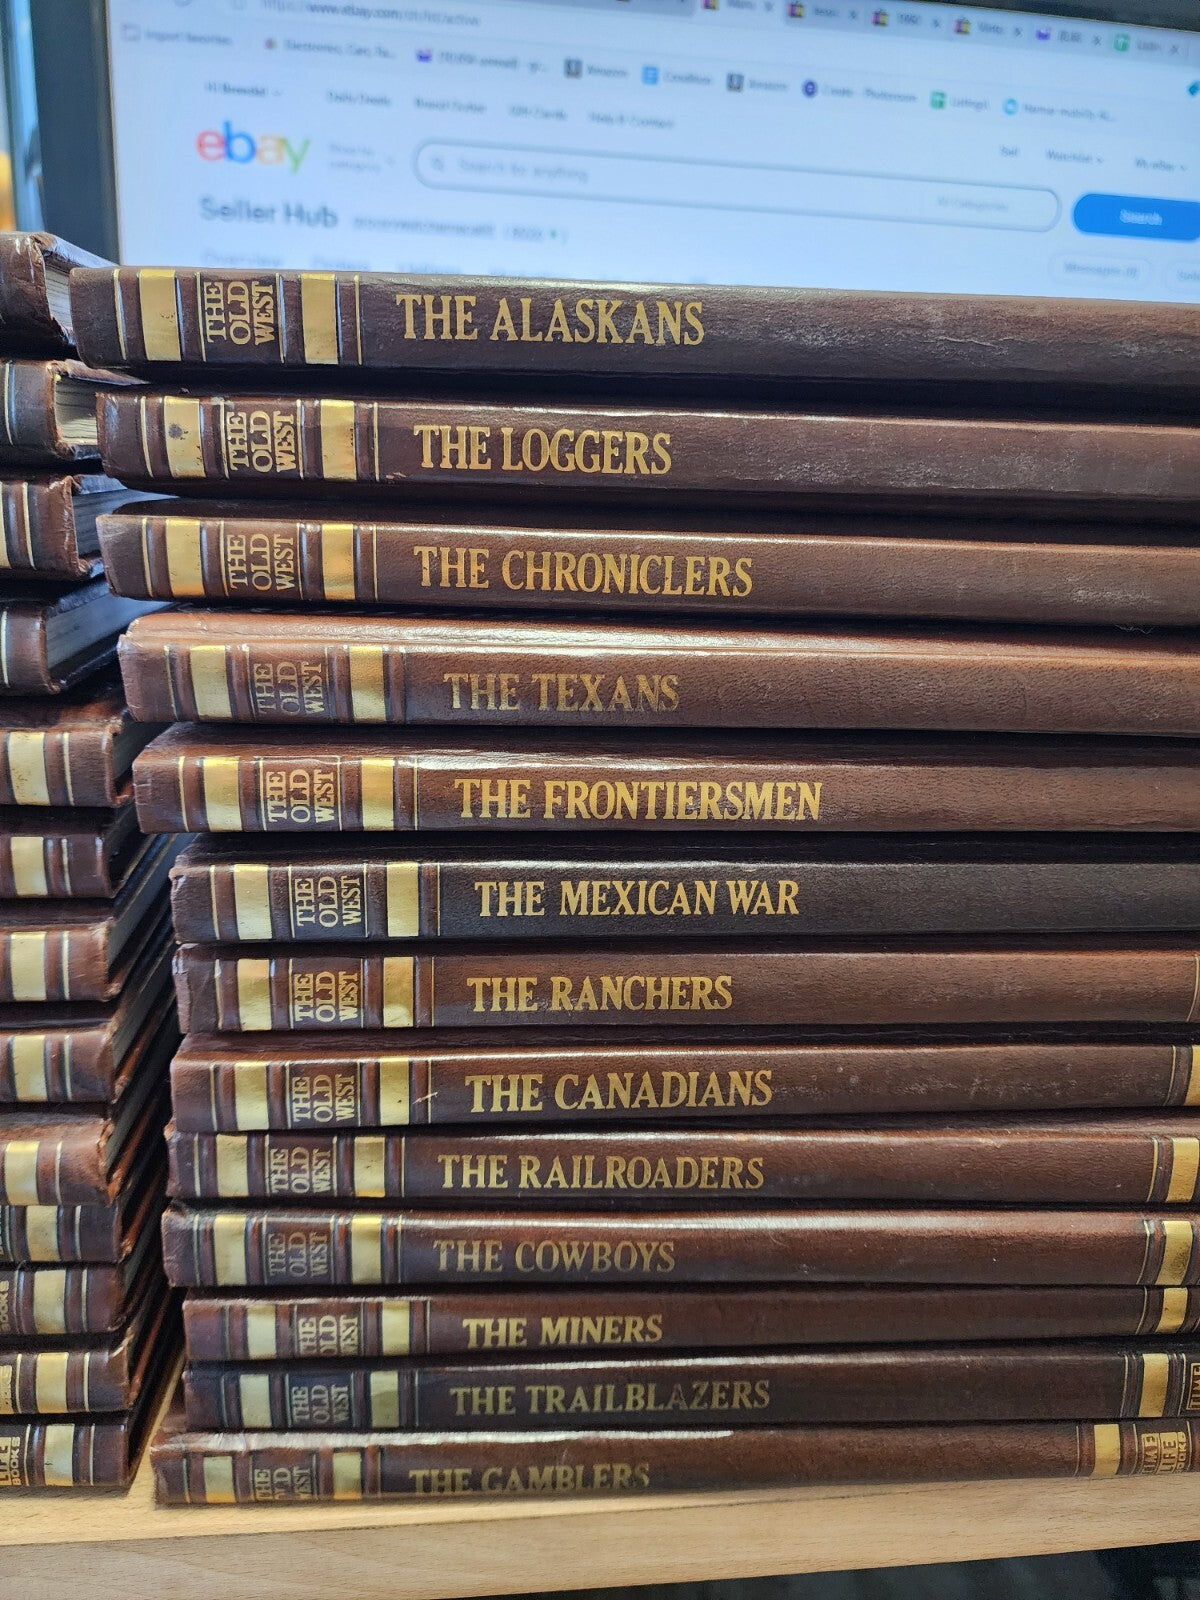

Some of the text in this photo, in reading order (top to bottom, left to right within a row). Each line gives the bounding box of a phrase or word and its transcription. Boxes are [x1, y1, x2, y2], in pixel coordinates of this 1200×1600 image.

[196, 120, 312, 174] ebay
[201, 196, 276, 223] Seller
[283, 201, 339, 229] Hub
[204, 281, 227, 343] THE
[228, 281, 252, 345] OLD
[251, 280, 275, 346] WEST
[395, 294, 705, 347] THE ALASKANS
[226, 411, 249, 471] THE
[250, 410, 273, 473] OLD
[273, 411, 297, 473] WEST
[413, 424, 672, 475] THE LOGGERS
[226, 534, 249, 589] THE
[250, 533, 272, 591] OLD
[273, 533, 296, 591] WEST
[413, 545, 753, 598] THE CHRONICLERS
[253, 663, 276, 714] THE
[276, 661, 301, 716] OLD
[300, 660, 325, 715] WEST
[443, 673, 680, 713] THE TEXANS
[265, 771, 288, 822] THE
[289, 769, 311, 823] OLD
[313, 769, 335, 824] WEST
[454, 778, 824, 821] THE FRONTIERSMEN
[294, 878, 316, 927] THE
[318, 876, 339, 928] OLD
[340, 875, 362, 927] WEST
[474, 880, 800, 917] THE MEXICAN WAR
[293, 973, 314, 1022] THE
[315, 971, 336, 1023] OLD
[338, 971, 359, 1023] WEST
[466, 975, 733, 1012] THE RANCHERS
[292, 1076, 312, 1123] THE
[312, 1074, 334, 1123] OLD
[335, 1073, 355, 1122] WEST
[465, 1069, 773, 1113] THE CANADIANS
[269, 1148, 289, 1194] THE
[290, 1146, 310, 1194] OLD
[312, 1147, 331, 1194] WEST
[437, 1154, 765, 1190] THE RAILROADERS
[268, 1233, 287, 1277] THE
[288, 1231, 307, 1278] OLD
[309, 1231, 329, 1277] WEST
[433, 1239, 676, 1273] THE COWBOYS
[462, 1313, 663, 1349] THE MINERS
[291, 1386, 310, 1422] THE
[311, 1384, 330, 1424] OLD
[331, 1384, 350, 1423] WEST
[449, 1379, 770, 1415] THE TRAILBLAZERS
[408, 1462, 650, 1494] THE GAMBLERS
